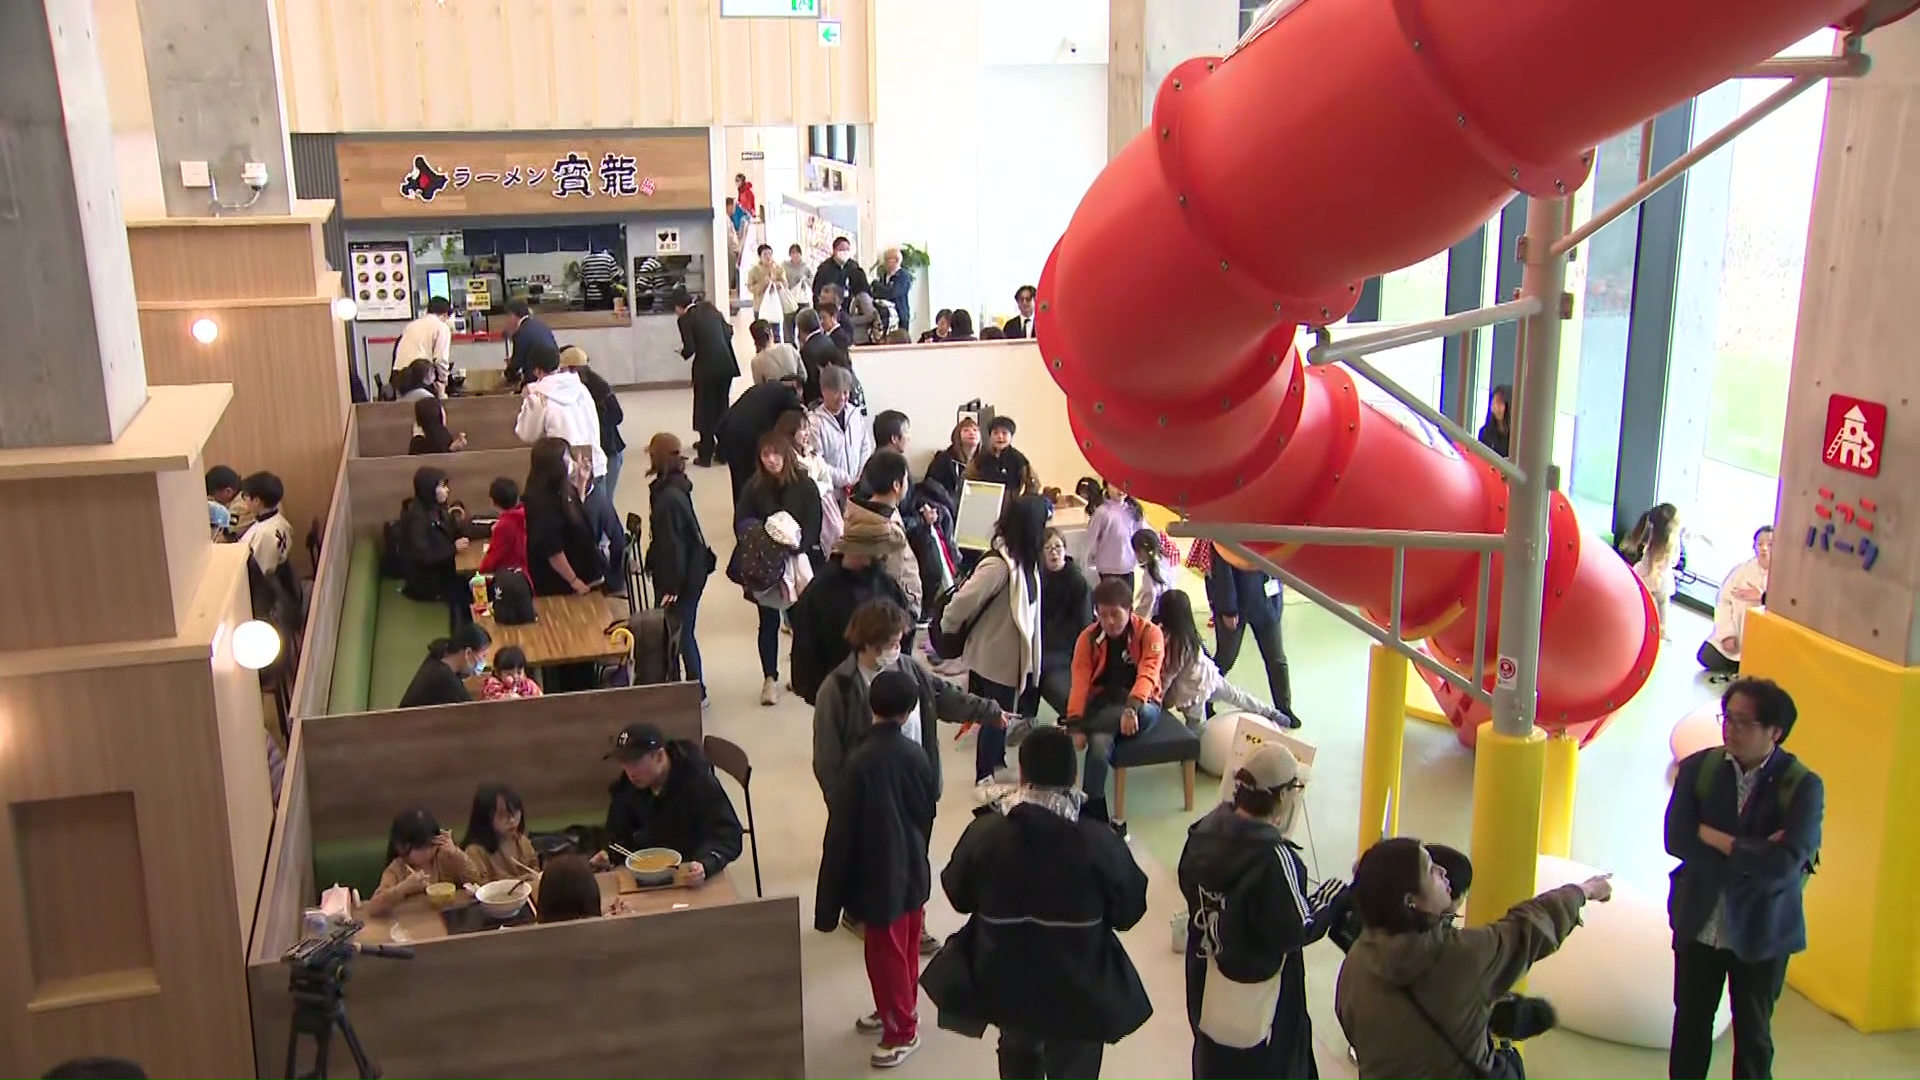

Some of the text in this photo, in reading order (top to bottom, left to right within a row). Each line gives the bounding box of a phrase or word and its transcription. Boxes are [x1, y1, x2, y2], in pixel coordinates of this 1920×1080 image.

[453, 166, 546, 187] ラーメン
[553, 152, 637, 197] 寶龍
[1806, 524, 1878, 571] パーク
